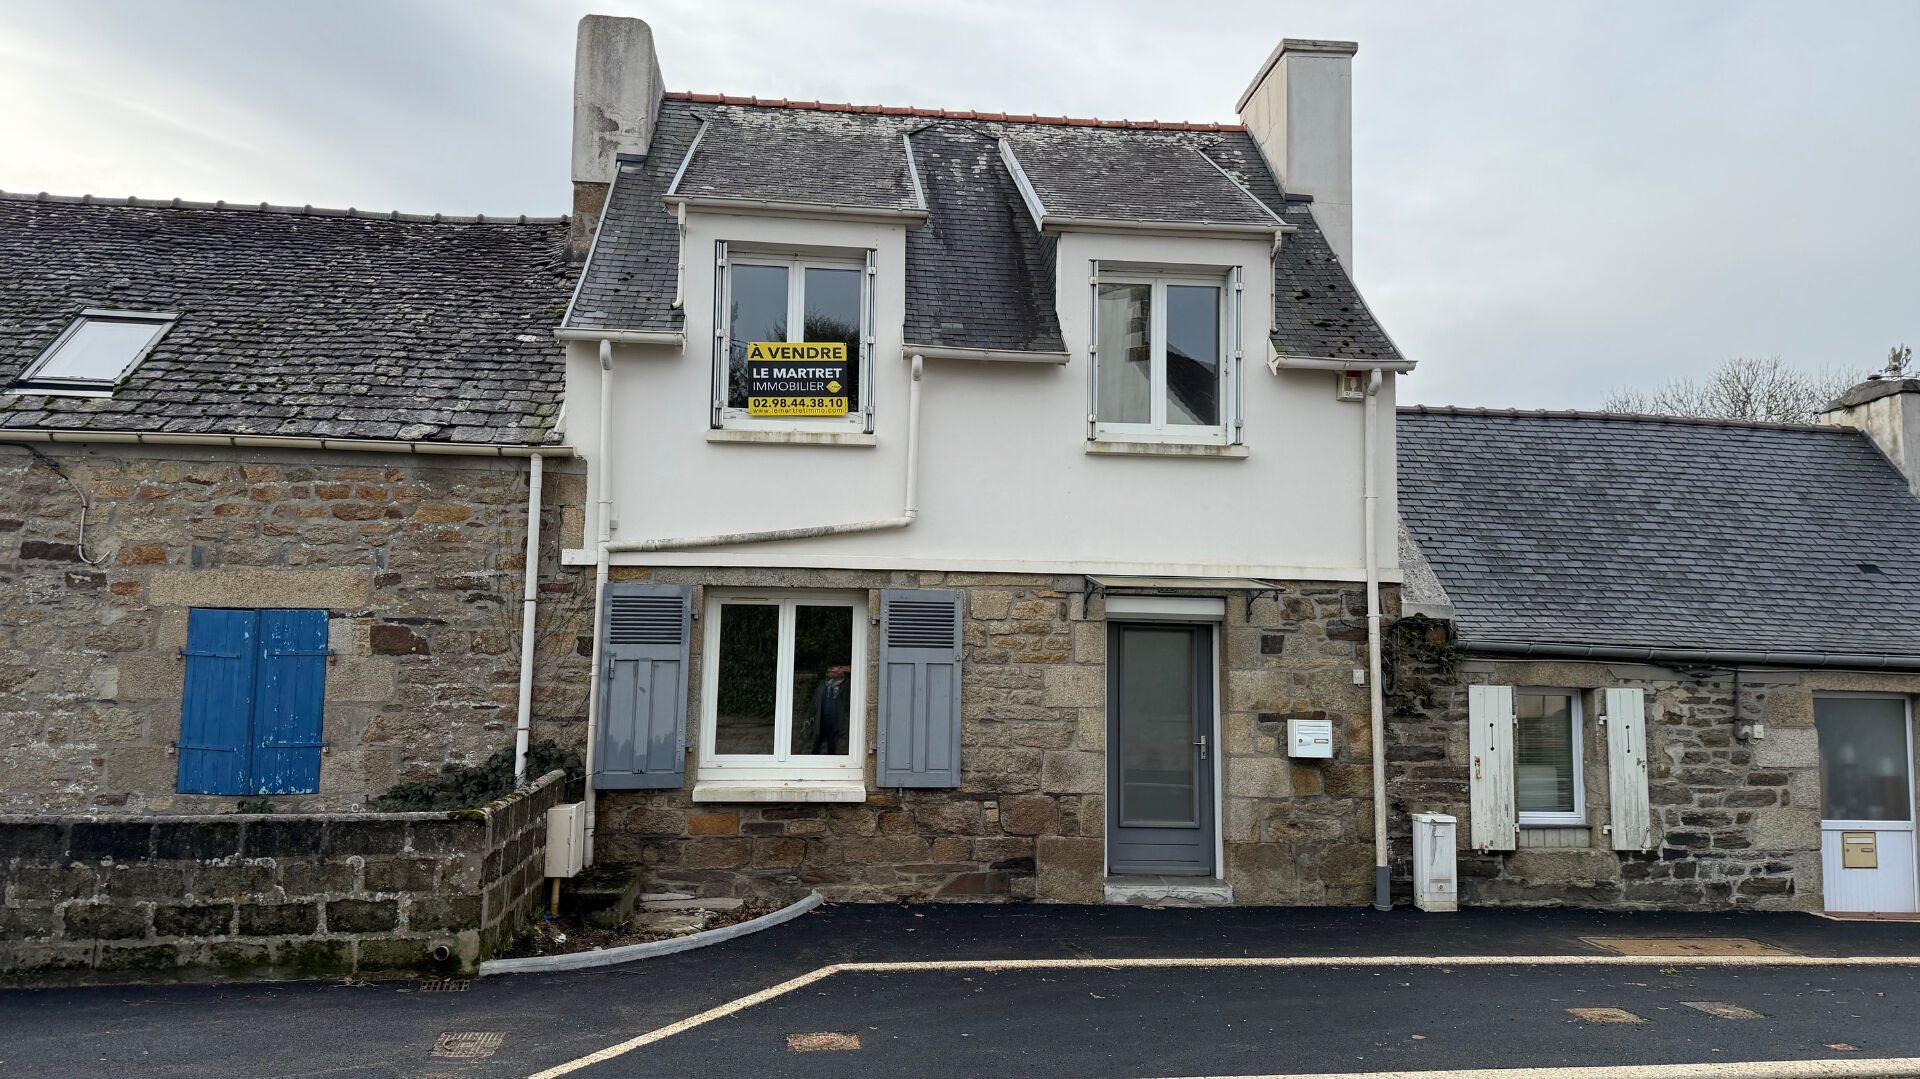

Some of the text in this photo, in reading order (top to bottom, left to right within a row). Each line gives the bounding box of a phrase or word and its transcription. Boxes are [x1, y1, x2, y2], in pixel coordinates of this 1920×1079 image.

[750, 343, 843, 359] À VENDRE
[753, 367, 843, 379] LE MARTRET
[753, 381, 824, 391] IMMOBILIER
[753, 398, 843, 408] 02.98.44.38.10
